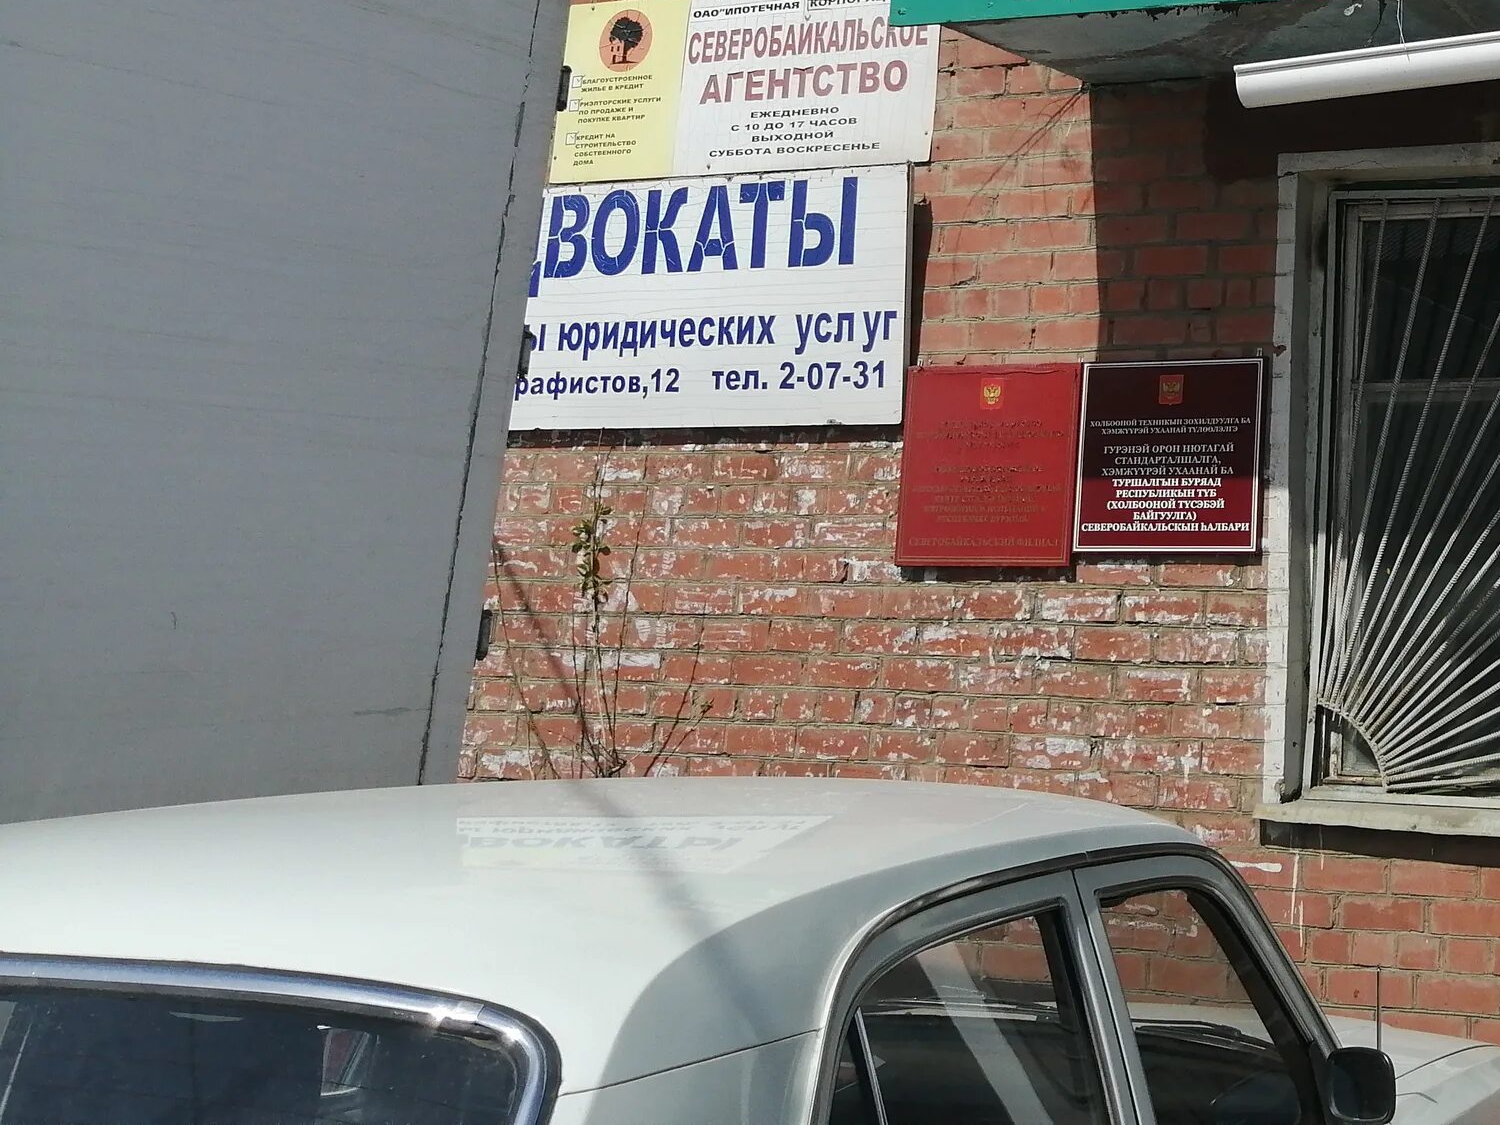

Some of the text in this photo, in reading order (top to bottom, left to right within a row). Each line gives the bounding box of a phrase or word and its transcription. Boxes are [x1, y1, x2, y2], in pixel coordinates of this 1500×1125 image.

[688, 13, 929, 65] СЕВЕРОБАЙКАЛЬСКОЕ
[582, 74, 653, 85] БЛАГОУСТРОЕННОЕ
[700, 59, 908, 105] АГЕНТСТВО
[581, 85, 607, 93] ЖИЛЬЕ
[579, 98, 632, 107] РИЭЛТОРСКИЕ
[590, 107, 626, 115] ПРОДАЖЕ
[750, 106, 840, 118] ЕЖЕДНЕВНО
[577, 114, 646, 124] ПОКУПКЕ КВАРТИР
[731, 117, 858, 132] С 10 ДО 17 ЧАСОВ
[576, 133, 603, 141] КРЕДИТ
[751, 130, 835, 143] ВЫХОДНОЙ
[575, 140, 637, 149] СТРОИТЕЛЬСТВО
[709, 142, 881, 158] СУББОТА ВОСКРЕСЕНЬЕ
[574, 148, 632, 158] СОБСТВЕННОГО
[528, 176, 859, 297] ВОКАТЫ
[558, 314, 776, 361] юридических
[712, 368, 768, 391] тел.
[779, 360, 885, 391] 2-07-31
[1152, 444, 1180, 454] ОРОН
[1182, 442, 1234, 453] НЮТАГАЙ
[1220, 466, 1234, 475] БА
[1181, 477, 1222, 487] БУРЯАД
[1115, 489, 1195, 498] РЕСПУБЛИКЫН
